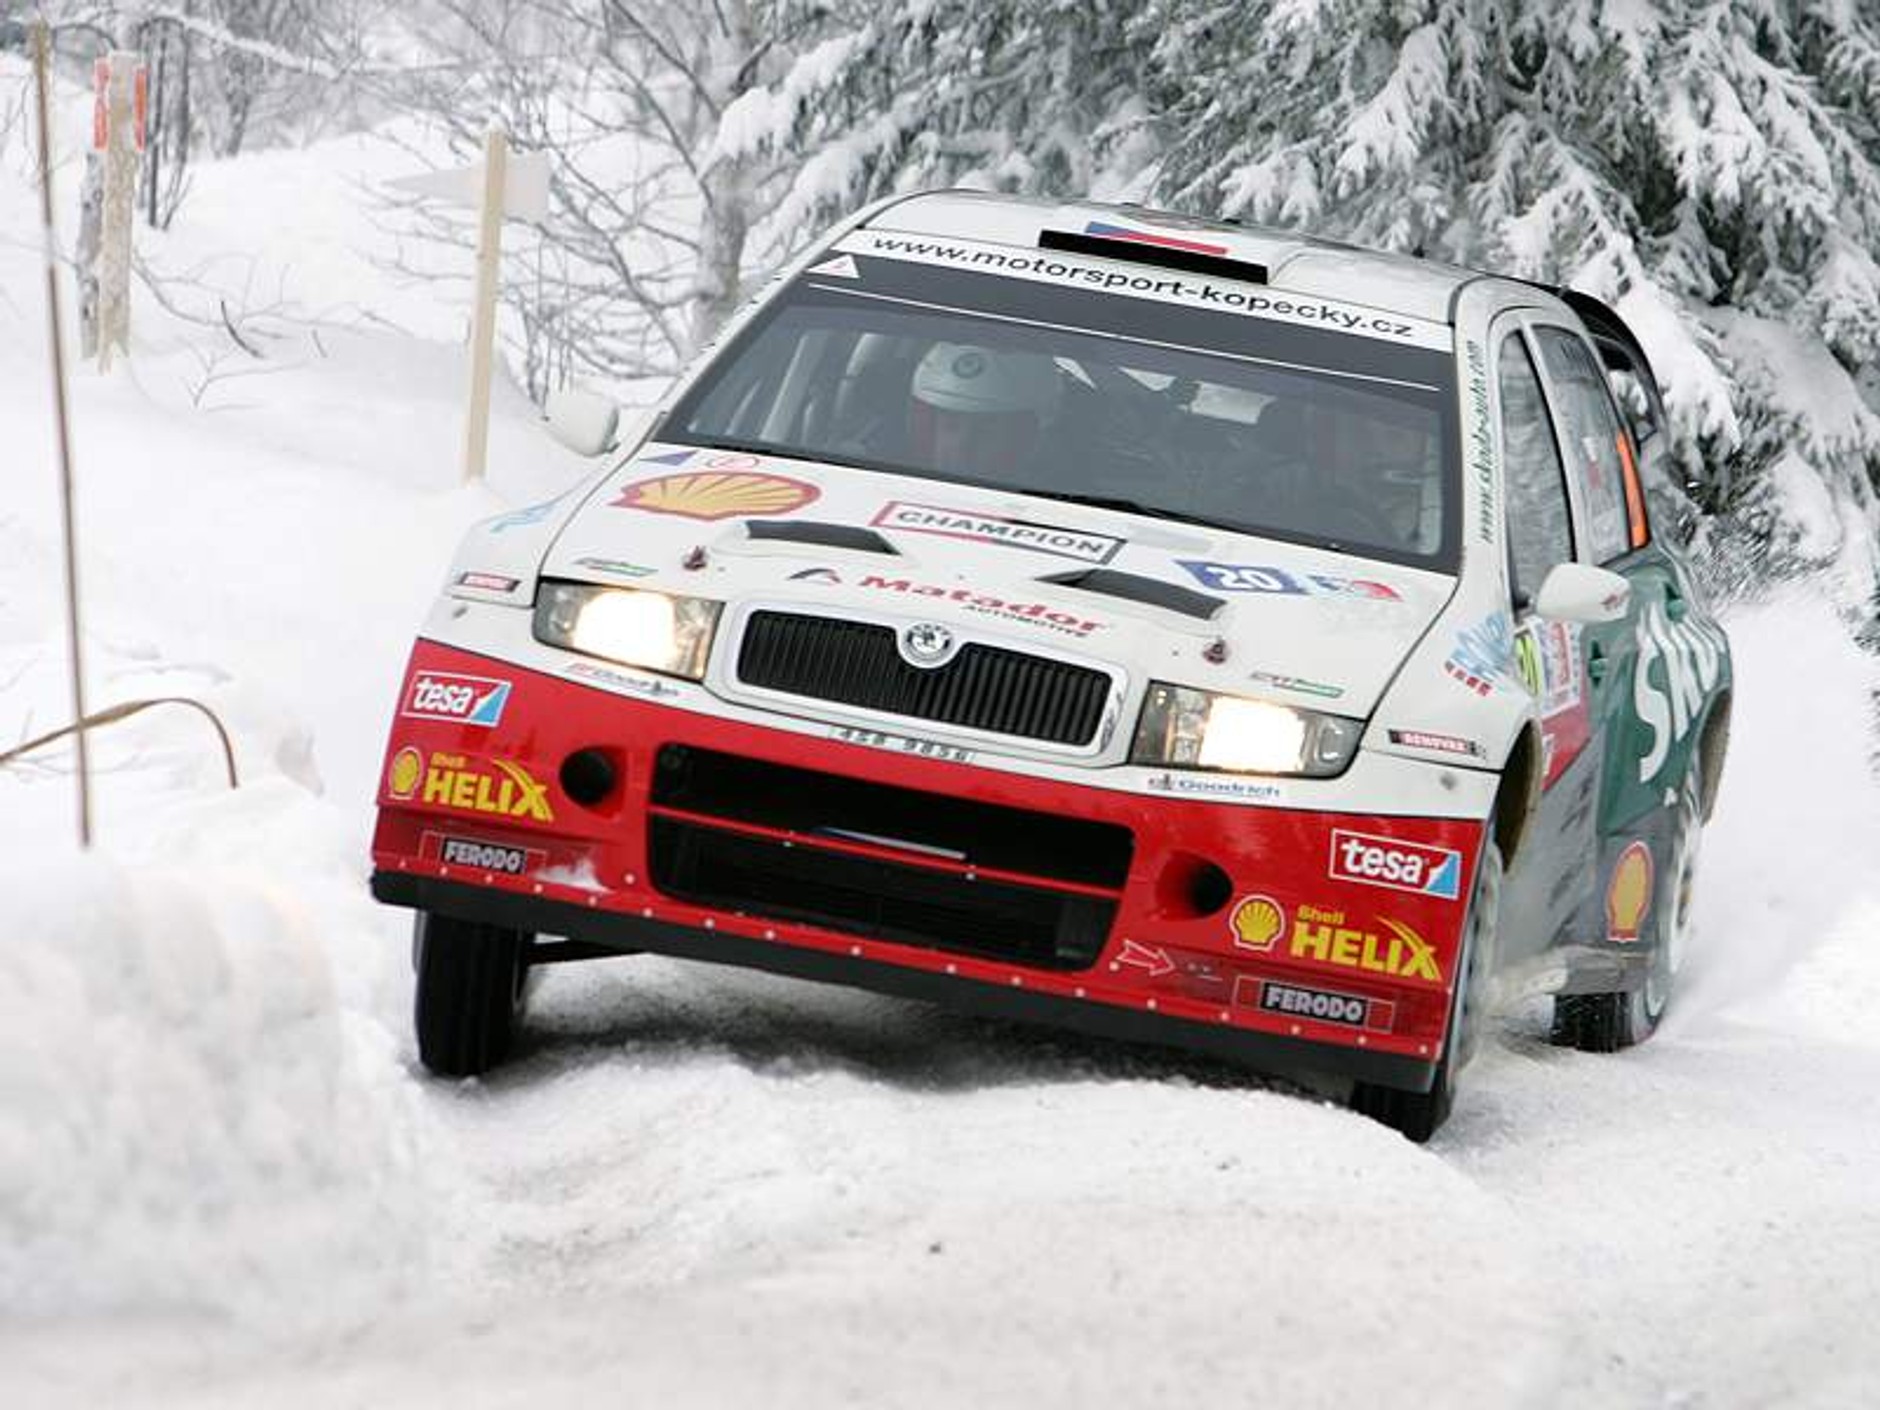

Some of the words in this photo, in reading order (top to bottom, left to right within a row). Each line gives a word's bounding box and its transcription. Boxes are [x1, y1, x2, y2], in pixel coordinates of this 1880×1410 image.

[873, 234, 1414, 339] www.motorsport-kopecky.cz
[896, 510, 1105, 555] CHAMPION
[1204, 566, 1284, 591] 20
[860, 575, 1106, 632] Matador
[960, 604, 1091, 638] AUTOMOTIVE
[412, 676, 474, 715] tesa
[423, 756, 554, 822] HELIX
[444, 839, 525, 871] FERODO
[1342, 839, 1423, 884] tesa
[1297, 904, 1346, 925] Shell
[1289, 914, 1444, 984] HELIX
[1265, 984, 1364, 1023] FERODO
